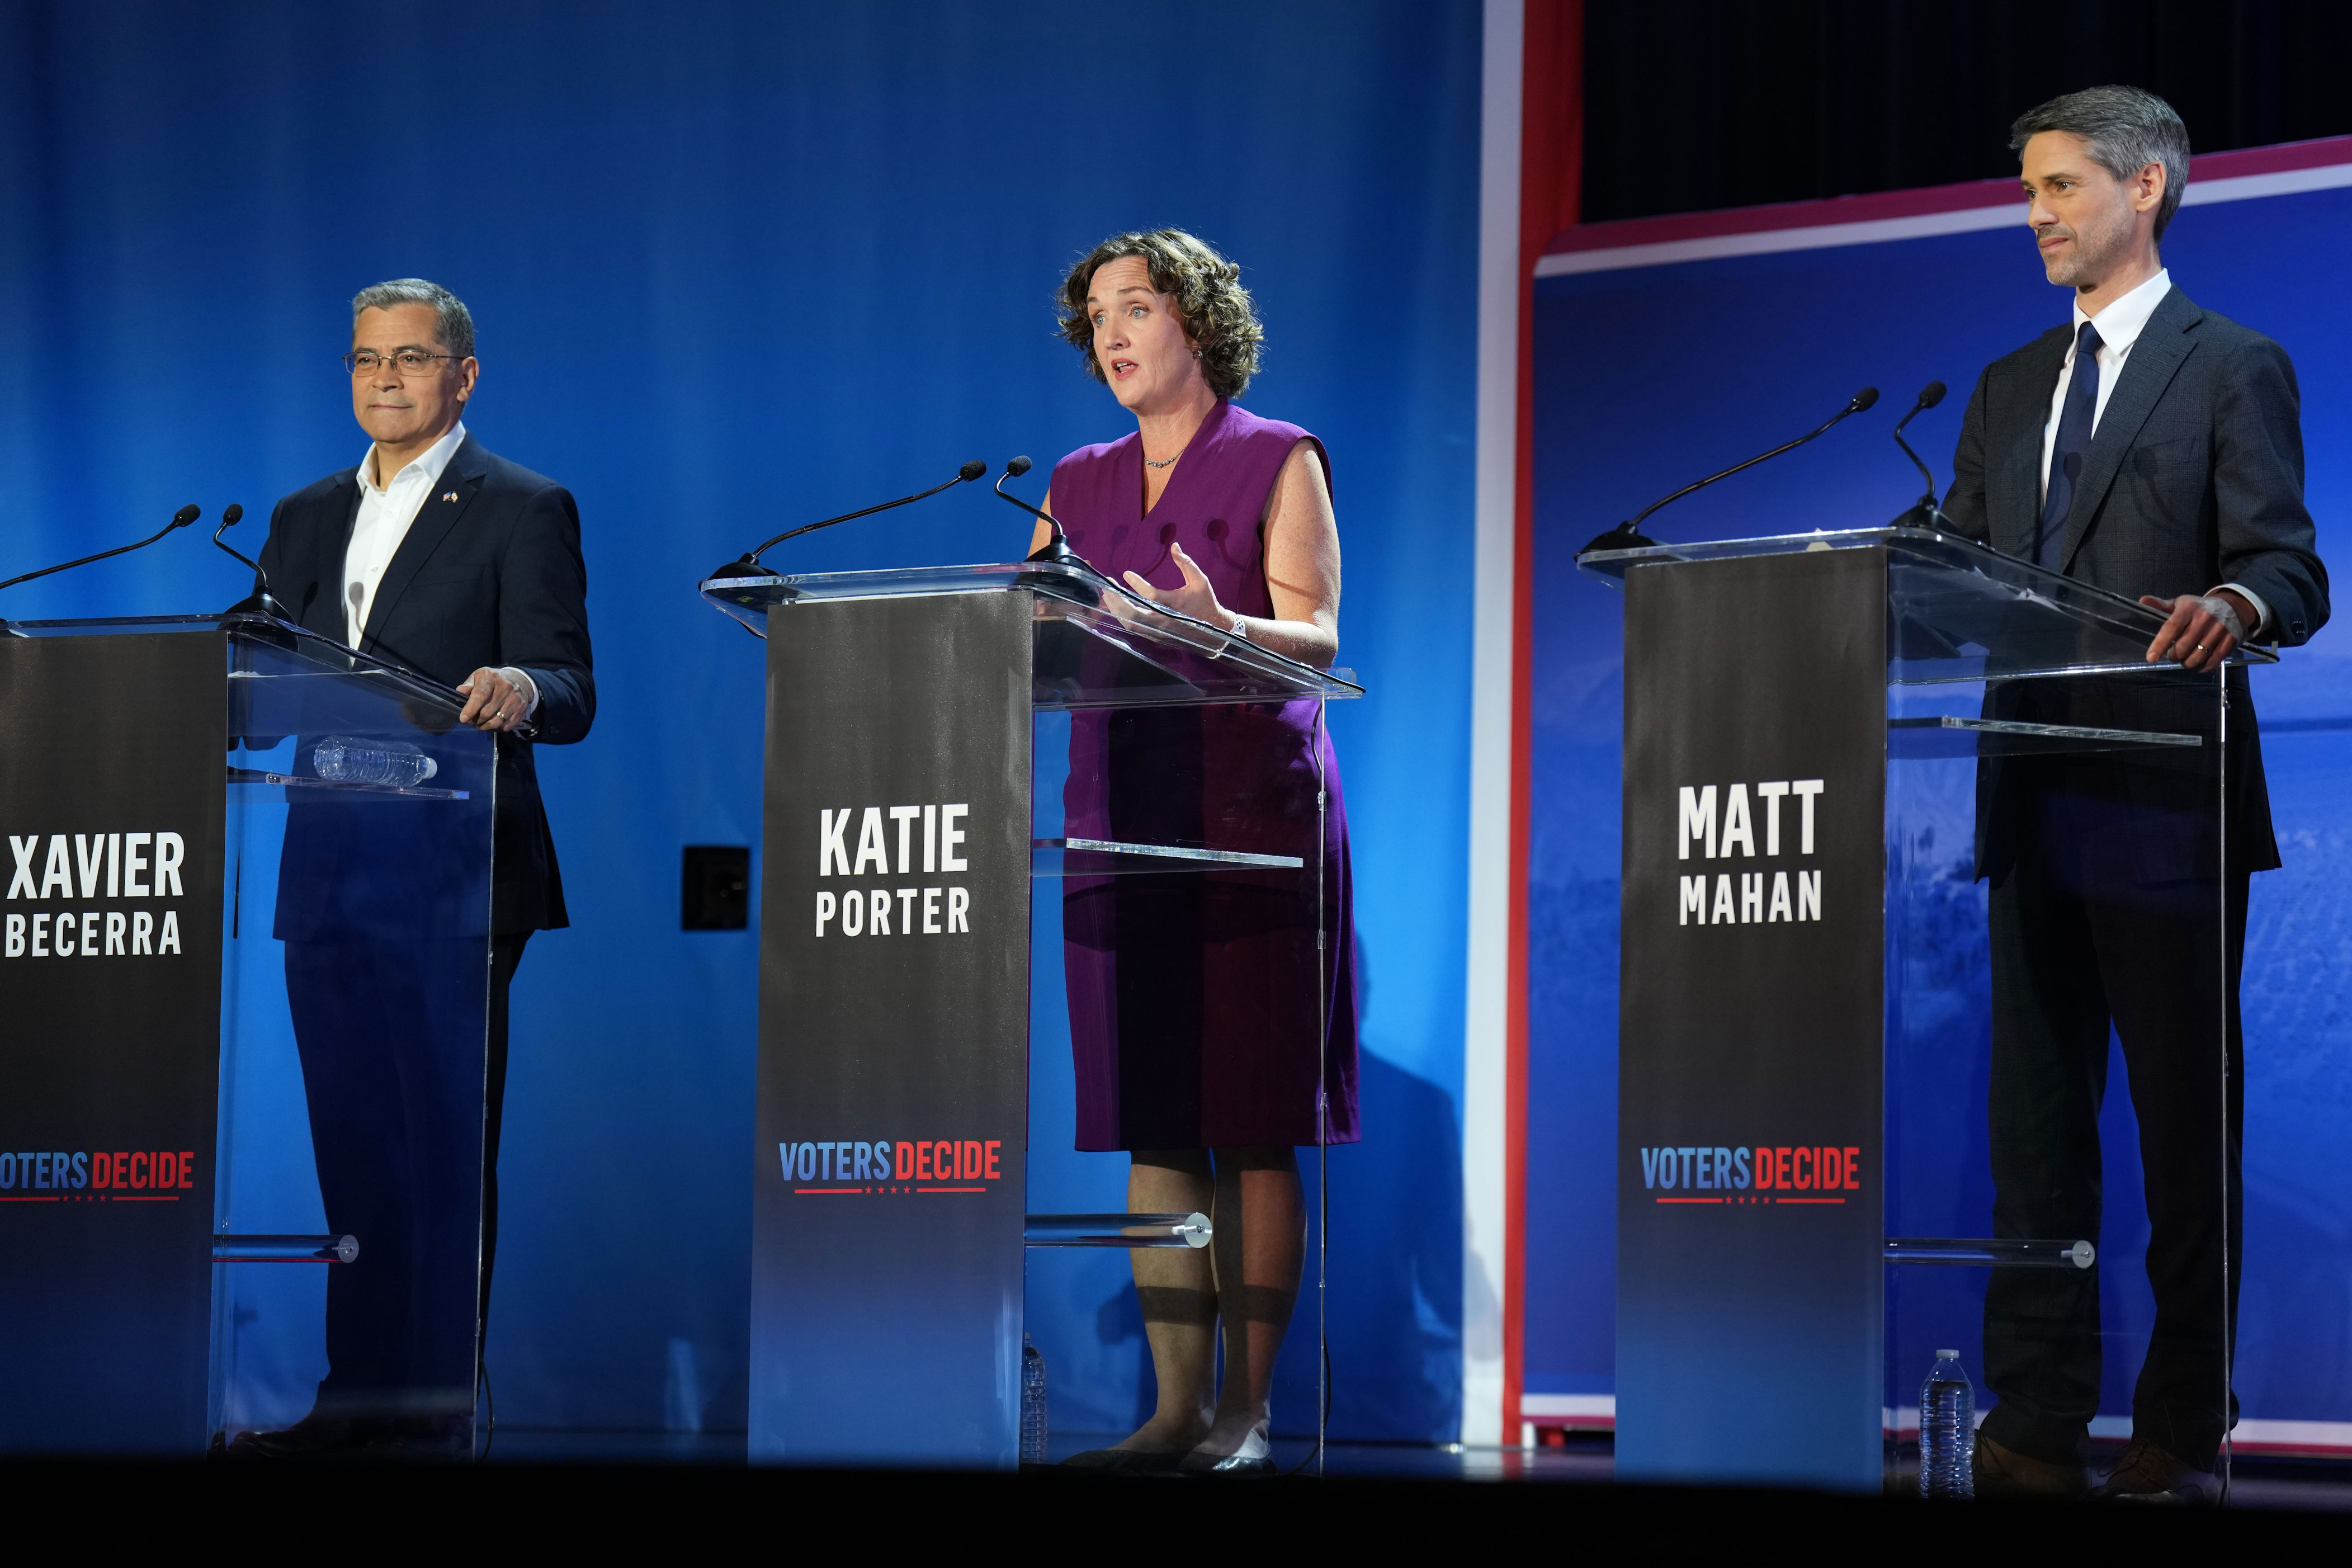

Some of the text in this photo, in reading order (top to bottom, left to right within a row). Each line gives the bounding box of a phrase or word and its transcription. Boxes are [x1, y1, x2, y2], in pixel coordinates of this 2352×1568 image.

[820, 804, 969, 876] KATIE
[1678, 779, 1824, 860] MATT
[7, 832, 185, 900] XAVIER
[815, 887, 970, 937] PORTER
[1679, 870, 1821, 925] MAHAN
[5, 910, 181, 958] BECERRA
[0, 1151, 88, 1189] OTERS
